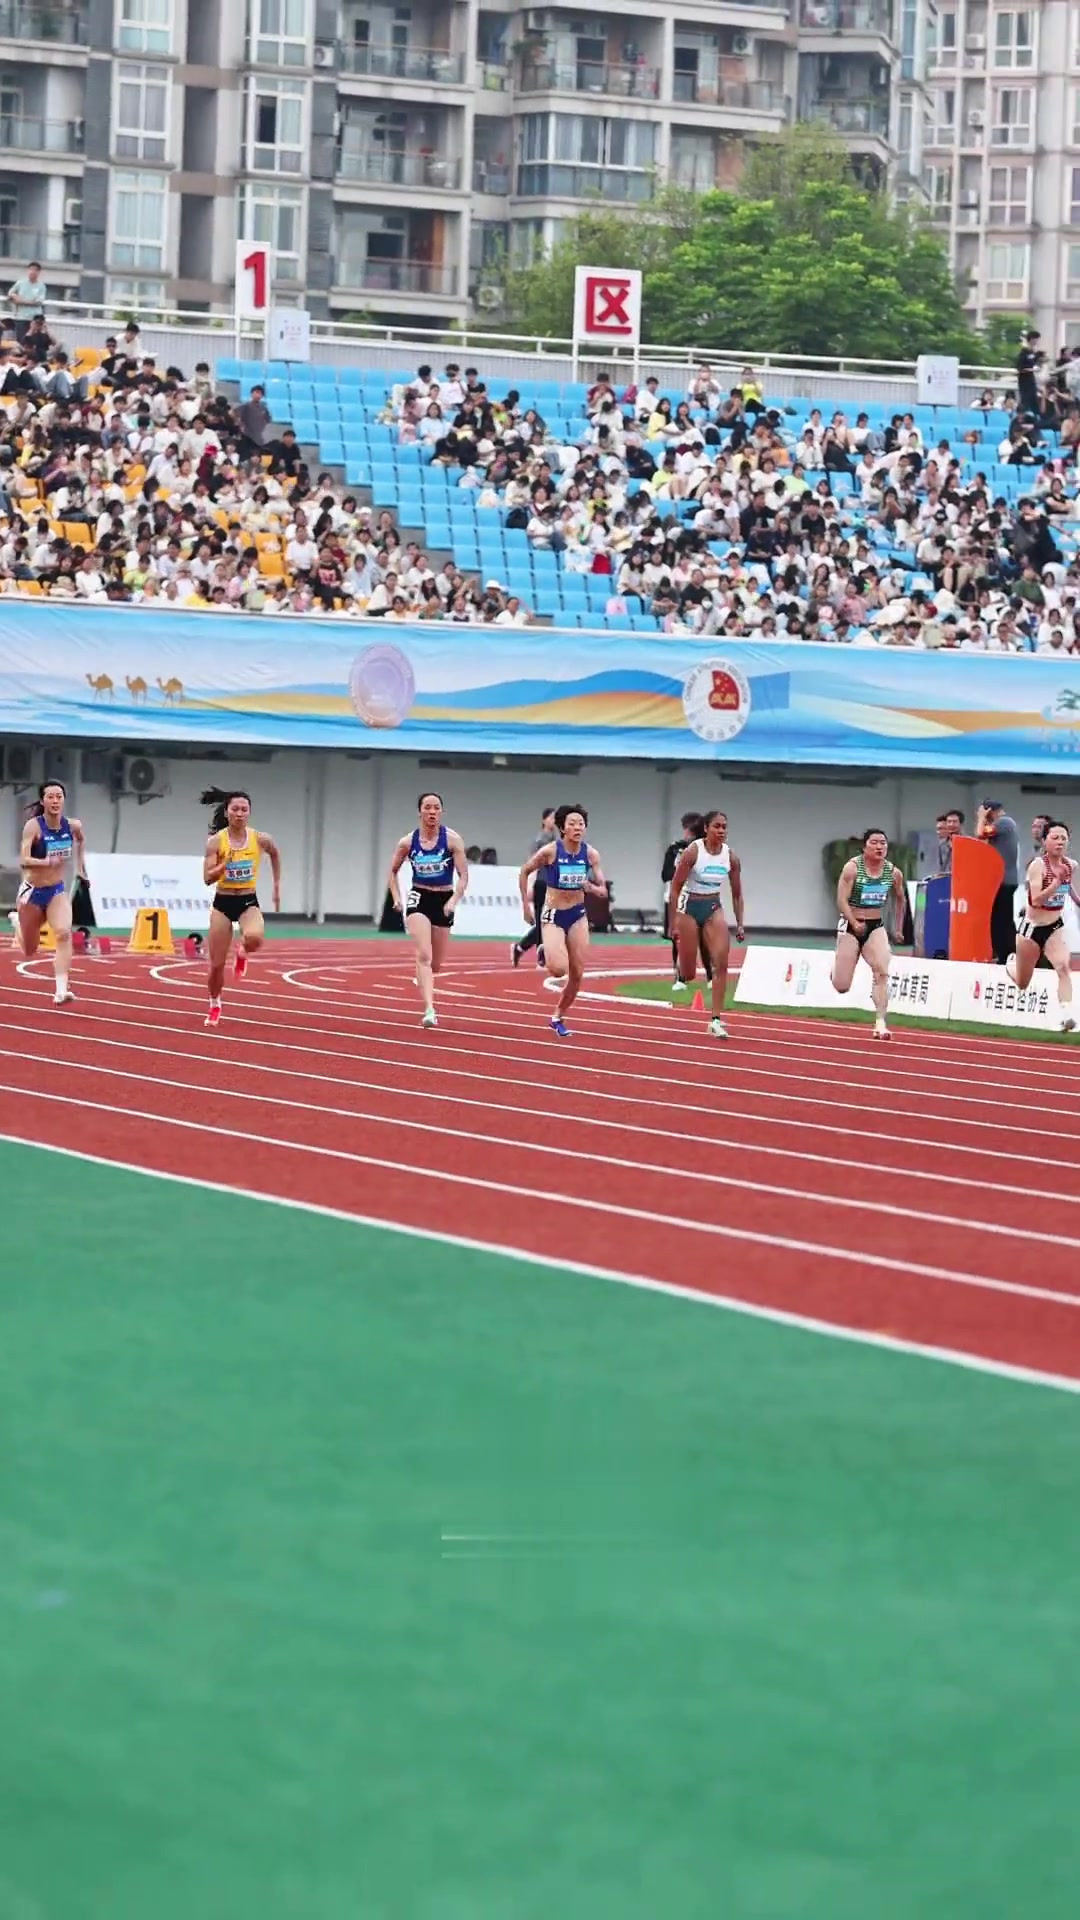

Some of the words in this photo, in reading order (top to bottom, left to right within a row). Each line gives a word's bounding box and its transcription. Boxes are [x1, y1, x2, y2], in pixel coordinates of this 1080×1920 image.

[244, 251, 265, 309] 1
[585, 277, 632, 334] 区
[19, 881, 33, 897] 7
[145, 911, 159, 941] 1
[870, 971, 929, 1005] 市体育局
